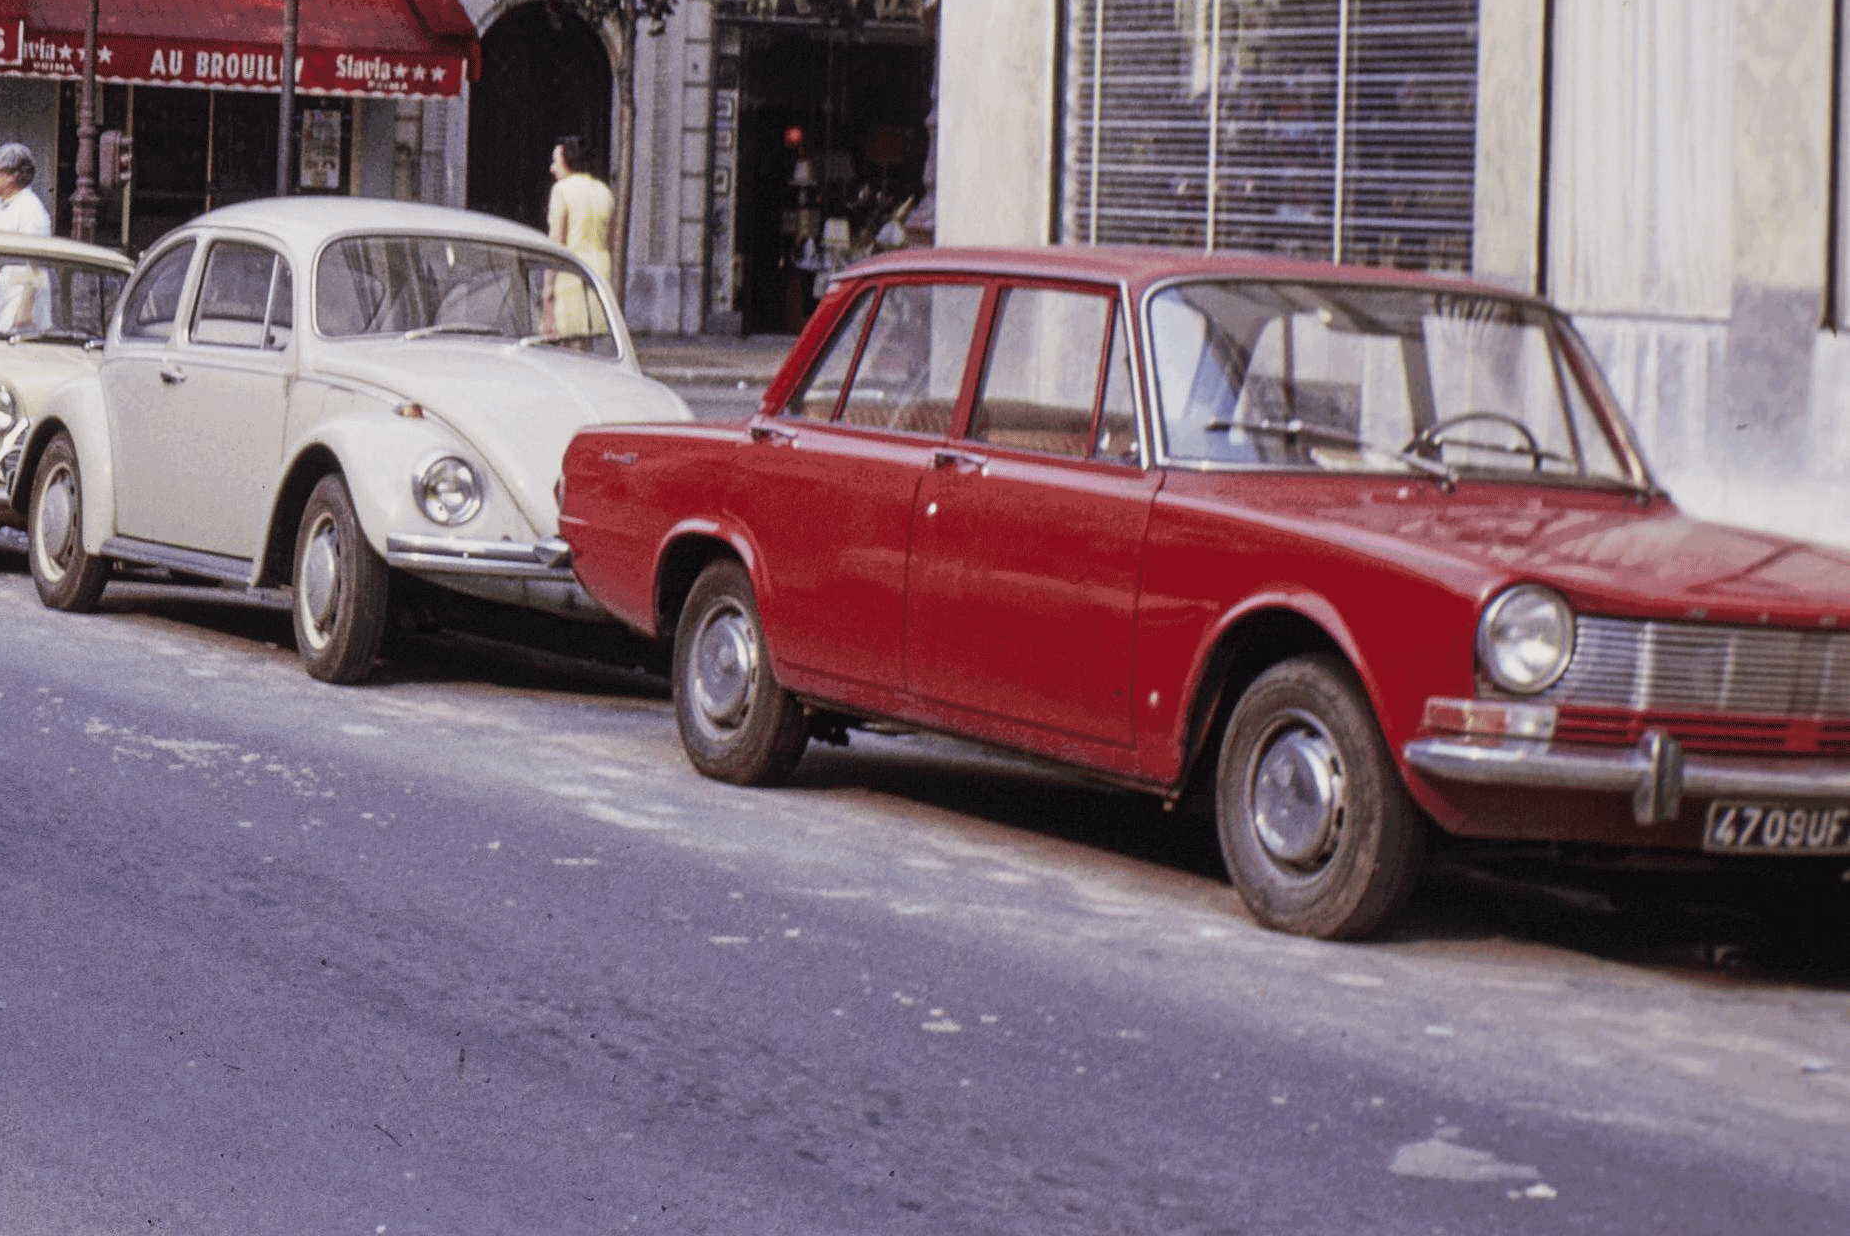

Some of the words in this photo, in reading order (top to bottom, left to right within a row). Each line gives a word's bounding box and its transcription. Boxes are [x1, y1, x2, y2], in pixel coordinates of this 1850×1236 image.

[150, 48, 184, 76] AU
[196, 50, 305, 83] BROUILY
[1714, 807, 1850, 848] 4709UF
